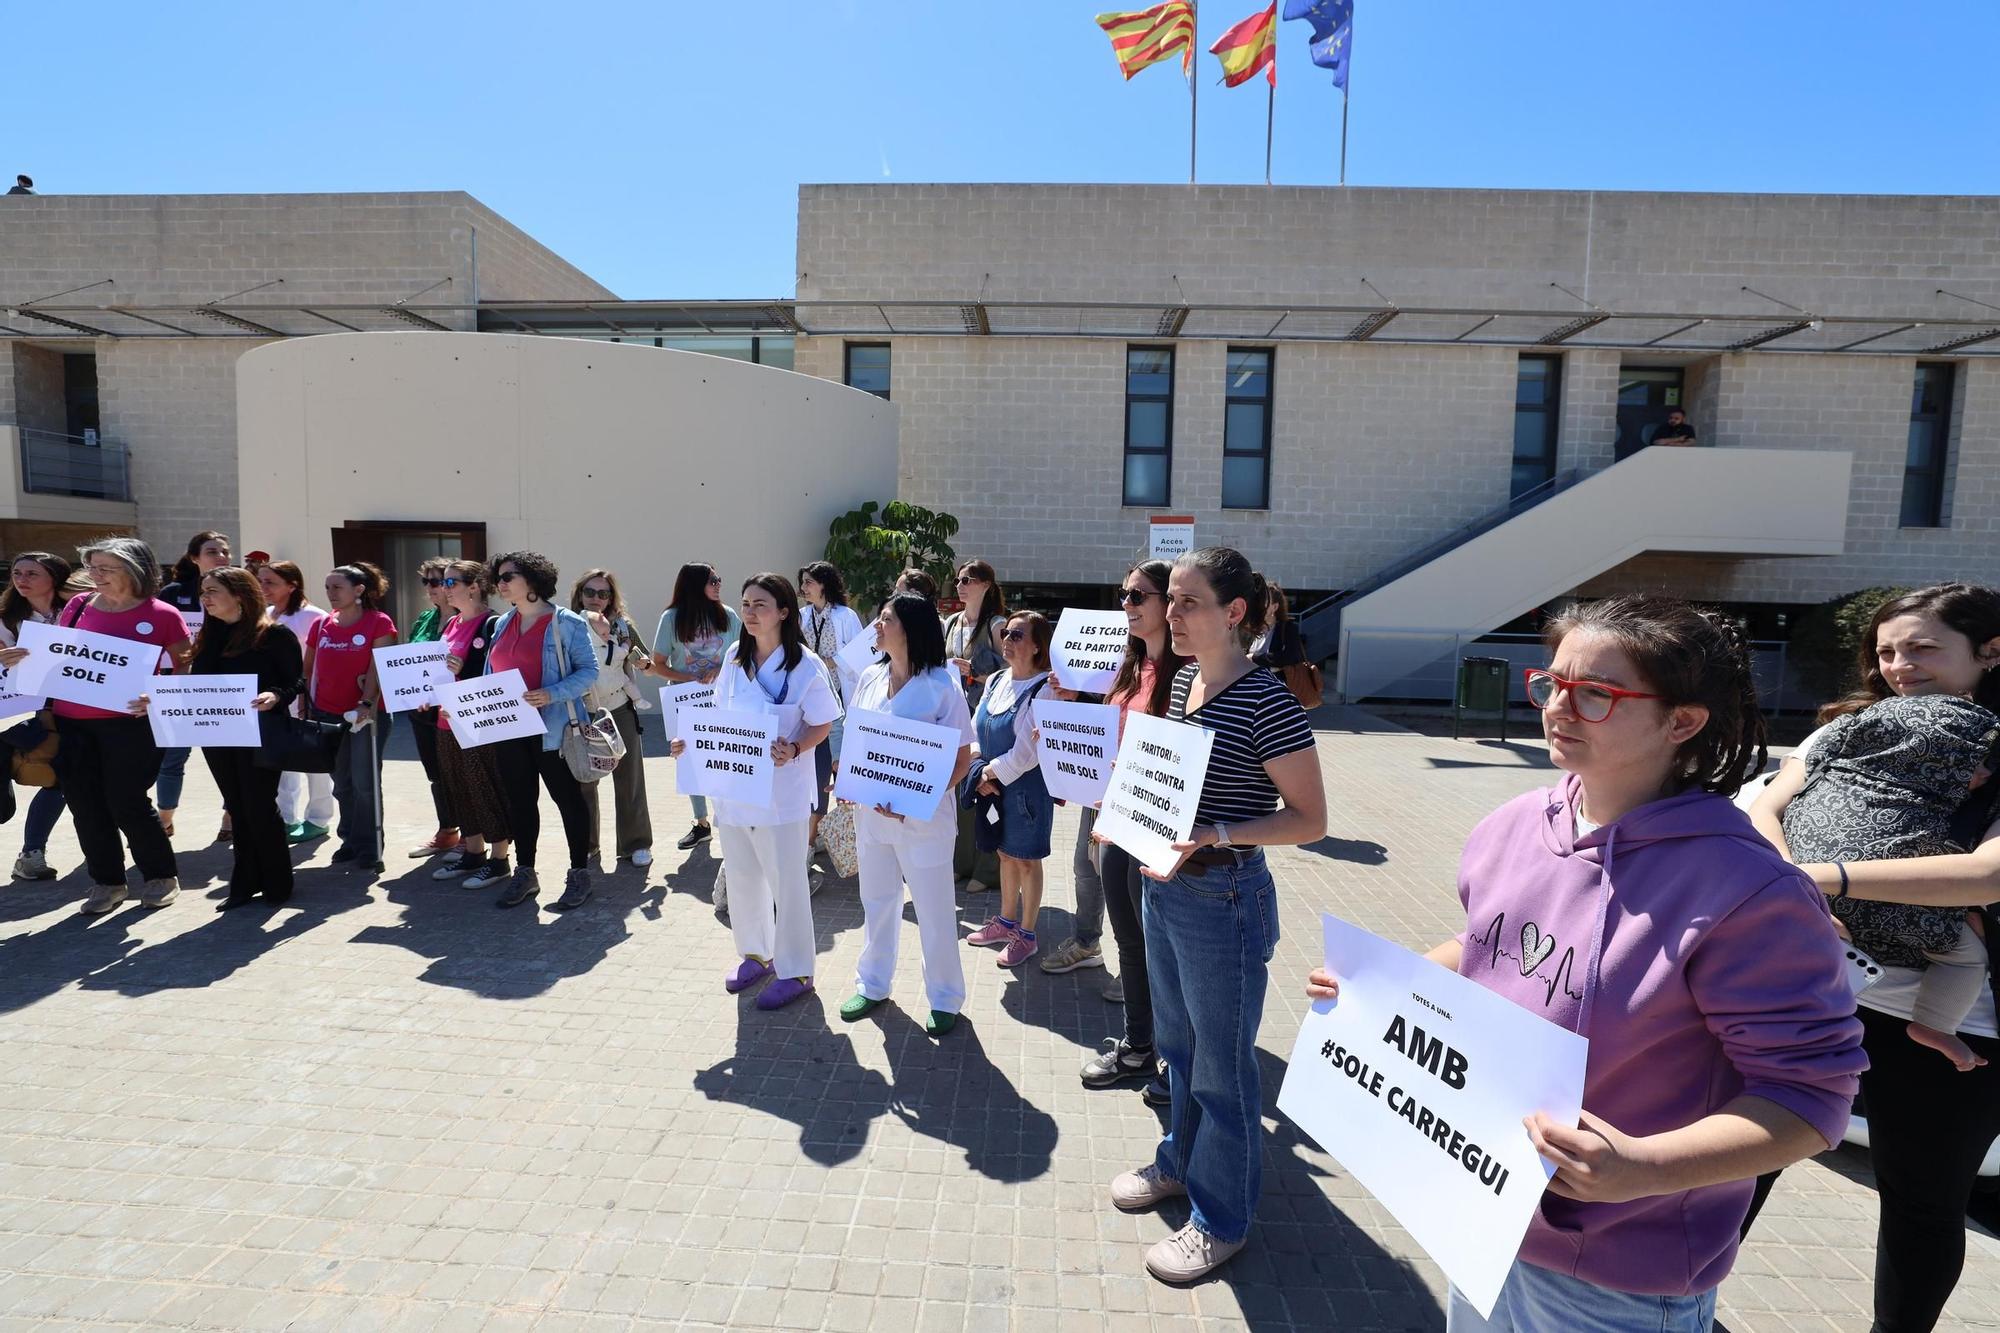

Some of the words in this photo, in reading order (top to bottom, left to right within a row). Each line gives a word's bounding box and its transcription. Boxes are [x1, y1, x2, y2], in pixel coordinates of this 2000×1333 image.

[1155, 546, 1188, 554] Principal
[1079, 625, 1097, 635] LES
[1099, 627, 1129, 636] TCAES
[49, 642, 129, 667] GRÀCIES
[1064, 641, 1082, 651] DEL
[386, 653, 447, 668] RECOLZAMENT
[1067, 658, 1091, 669] AMB
[1092, 661, 1117, 672] SOLE
[62, 666, 106, 684] SOLE
[394, 686, 420, 696] #Sole
[458, 693, 475, 703] LES
[475, 687, 504, 699] TCAES
[675, 694, 688, 702] LES
[161, 708, 194, 717] #SOLE
[196, 708, 245, 716] CARREGUI
[457, 708, 476, 718] DEL
[476, 699, 519, 714] PARITORI
[473, 717, 495, 729] AMB
[495, 714, 518, 725] SOLE
[1042, 720, 1052, 729] ELS
[1052, 721, 1105, 737] GINECOLEGS/UES
[693, 724, 707, 732] ELS
[708, 725, 766, 739] GINECOLEGS/UES
[858, 725, 880, 735] CONTRA
[889, 732, 920, 744] INJUSTICIA
[929, 741, 943, 749] UNA
[696, 739, 716, 750] DEL
[718, 741, 763, 757] PARITORI
[1045, 737, 1060, 751] DEL
[1062, 740, 1103, 759] PARITORI
[1141, 741, 1173, 762] PARITORI
[1172, 752, 1181, 765] de
[705, 759, 730, 771] AMB
[732, 762, 754, 775] SOLE
[867, 751, 925, 773] DESTITUCIÓ
[1057, 761, 1076, 775] AMB
[1077, 766, 1099, 780] SOLE
[850, 765, 933, 794] INCOMPRENSIBLE
[1145, 769, 1154, 780] en
[1154, 770, 1185, 792] CONTRA
[1132, 785, 1171, 811] DESTITUCIÓ
[1171, 804, 1180, 817] de
[1131, 809, 1178, 843] SUPERVISORA
[1412, 992, 1430, 1008] TOTES
[1430, 1003, 1436, 1011] A
[1436, 1007, 1453, 1022] UNA:
[1382, 1014, 1469, 1090] AMB
[1320, 1039, 1385, 1098] #SOLE
[1387, 1086, 1509, 1196] CARREGUI
